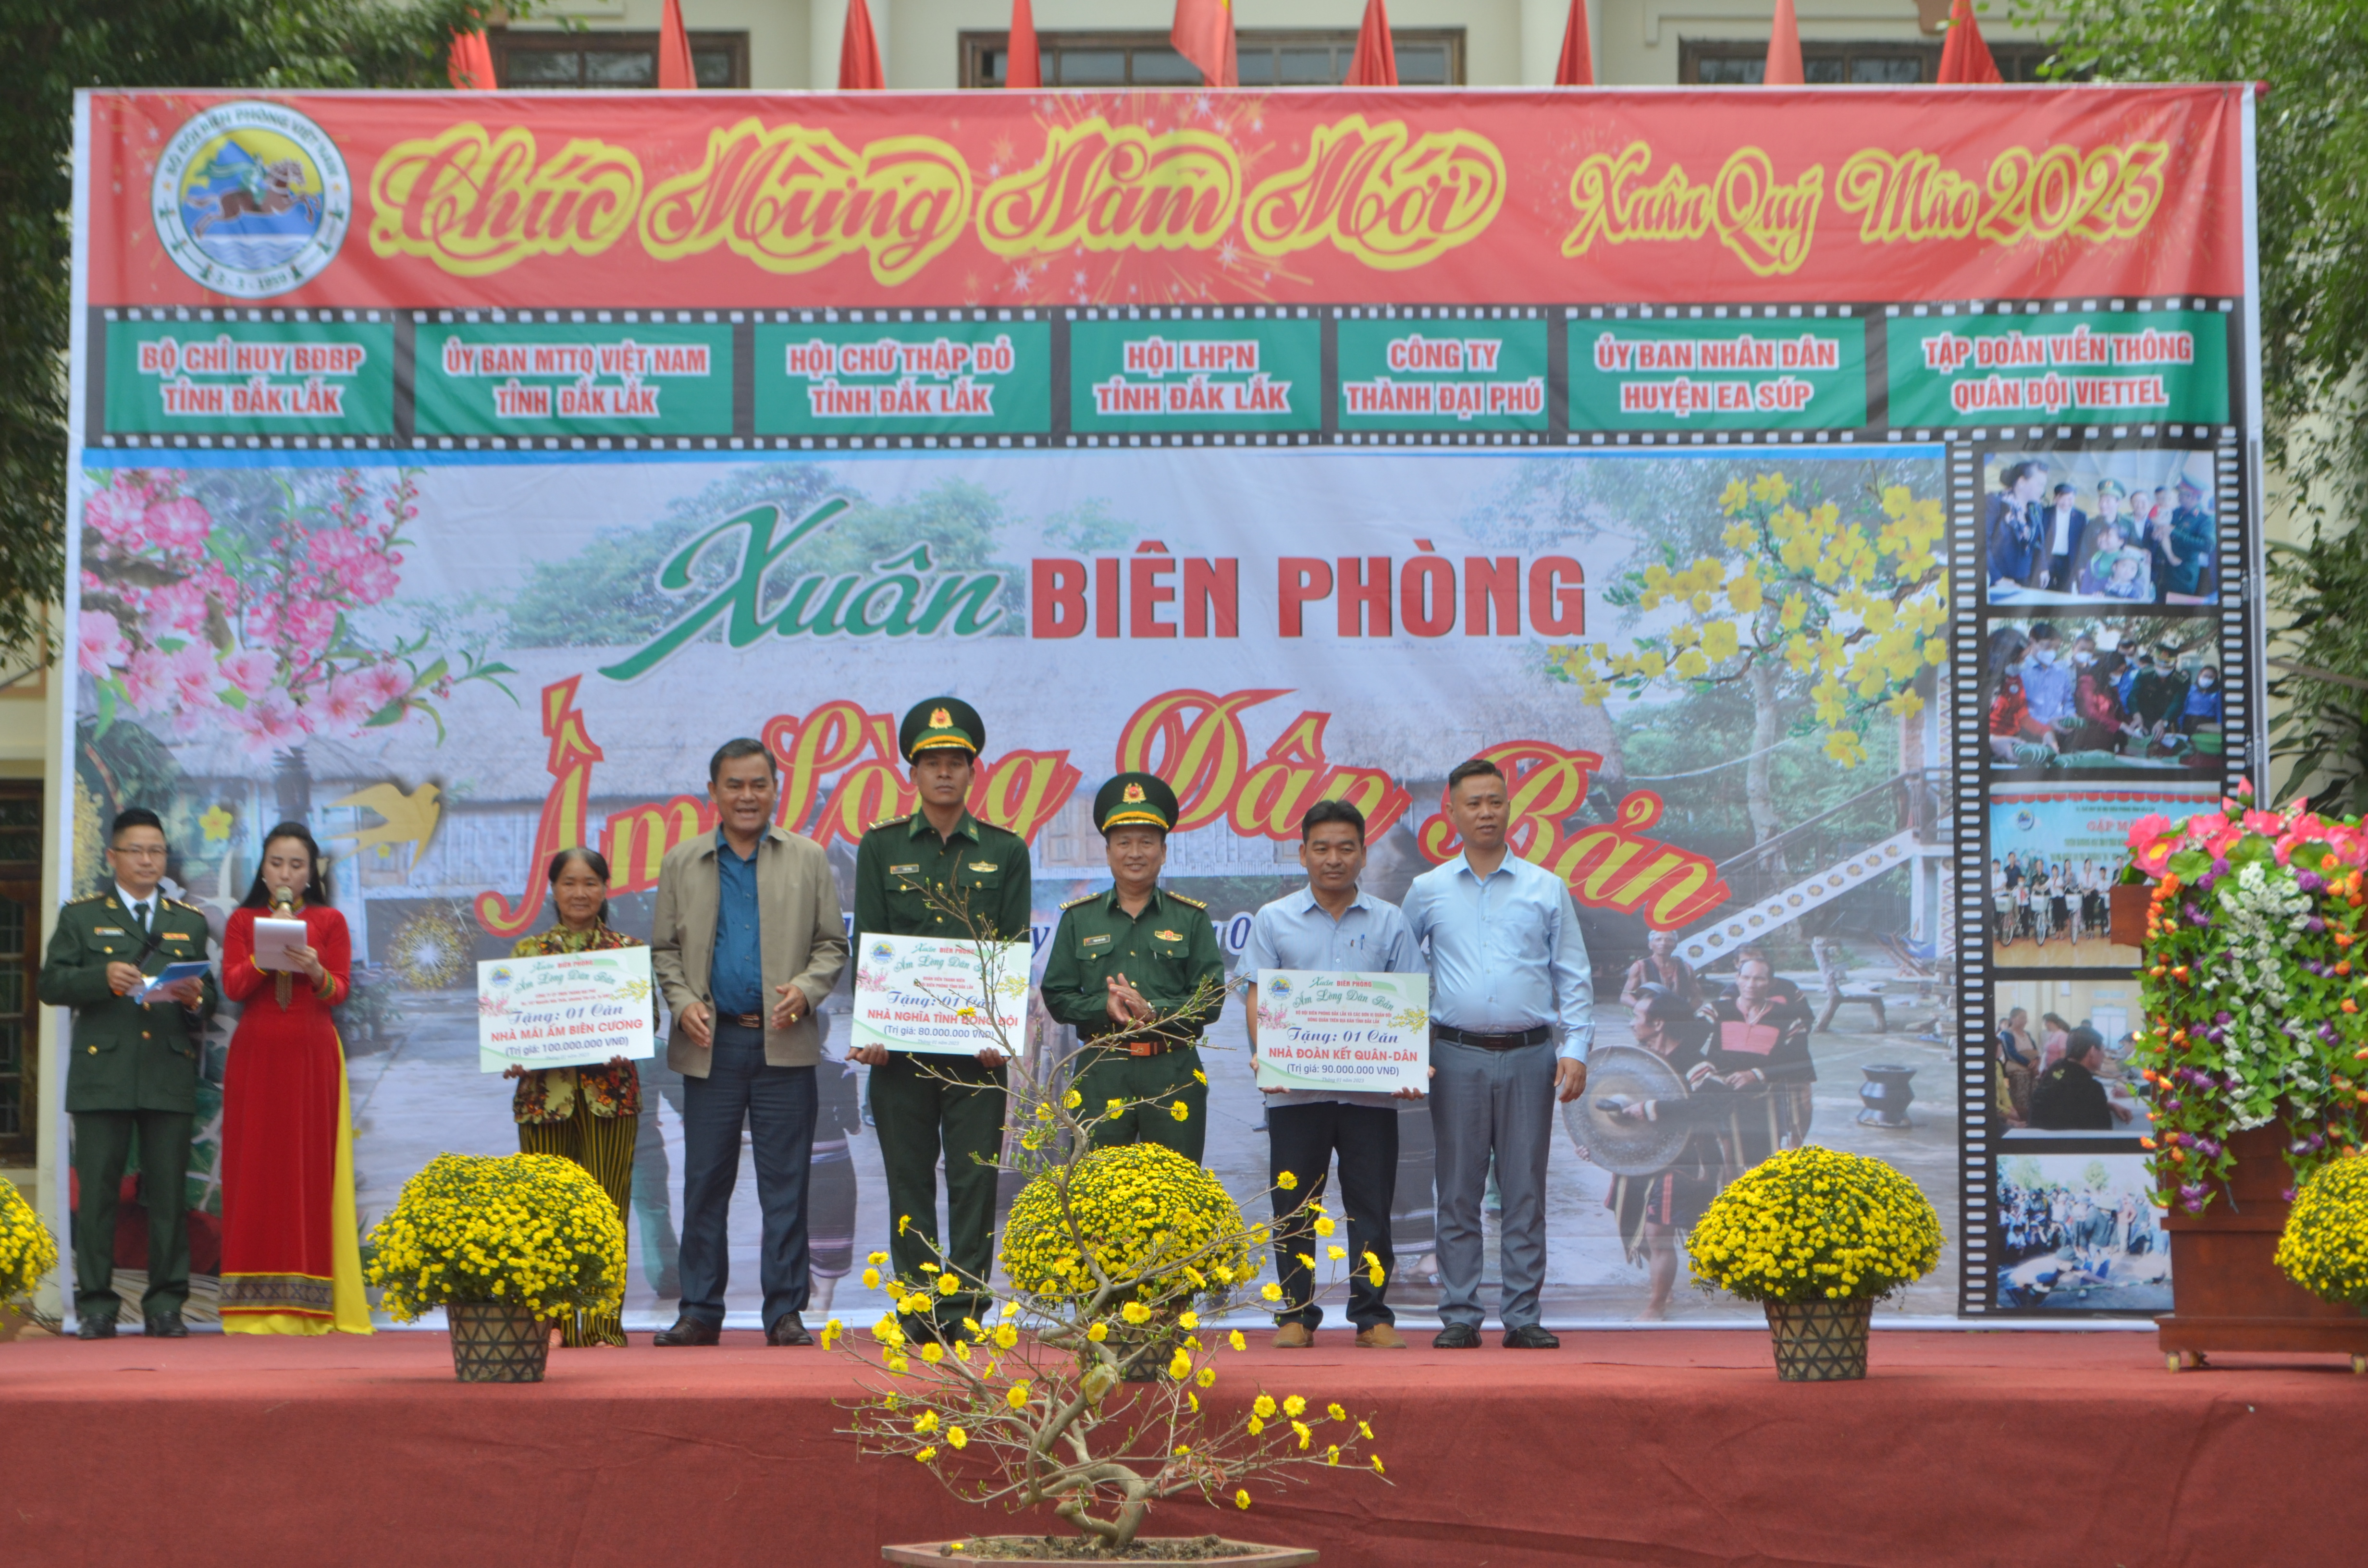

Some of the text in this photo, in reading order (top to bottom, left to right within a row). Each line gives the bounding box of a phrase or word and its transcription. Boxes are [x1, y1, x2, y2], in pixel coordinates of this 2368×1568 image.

[370, 113, 1506, 287] Chúc Mừng Năm Mới
[1561, 140, 2170, 277] Xuân Quý Mão 2023
[142, 338, 362, 375] BỘ CHỈ HUY BĐBP
[446, 338, 706, 376] ỦY BAN MTTQ VIỆT NAM
[789, 338, 1011, 377] HỘI CHỮ THẬP ĐỎ
[1127, 339, 1256, 375] HỘI LHPN
[1389, 338, 1498, 368] CÔNG TY
[1597, 336, 1836, 368] ỦY BAN NHÂN DÂN
[1924, 334, 1971, 371] TẬP
[1976, 333, 2045, 366] ĐOÀN
[2112, 331, 2192, 363] THÔNG
[165, 379, 340, 412] TỈNH ĐẮK LẮK
[497, 381, 655, 413] TỈNH ĐẮK LẮK
[812, 380, 989, 413] TỈNH ĐẮK LẮK
[1097, 376, 1286, 411] TỈNH ĐẮK LẮK
[1346, 379, 1542, 417] THÀNH ĐẠI PHÚ
[1624, 379, 1811, 415] HUYỆN EA SÚP
[1953, 375, 2166, 411] QUÂN ĐỘI VIETTEL
[597, 496, 1586, 680] Xuân BIÊN PHÒNG
[1309, 976, 1333, 988] Xuân
[868, 1009, 891, 1020] NHÀ
[895, 1011, 930, 1023] NGHĨA
[934, 1012, 958, 1024] TÌNH
[888, 991, 960, 1009] Tặng: 01
[1293, 988, 1394, 1012] Ấm Lòng Dân Bản
[491, 1019, 643, 1042] NHÀ MÁI ẤM BIÊN CƯƠNG
[884, 1025, 899, 1037] (Trị
[901, 1027, 916, 1037] giá:
[918, 1027, 970, 1038] 80.000.000
[1287, 1027, 1399, 1044] Tặng: 01 Căn
[1269, 1045, 1418, 1062] NHÀ ĐOÀN KẾT QUÂN-DÂN
[1287, 1064, 1399, 1077] (Trị giá: 90.000.000 VNĐ)
